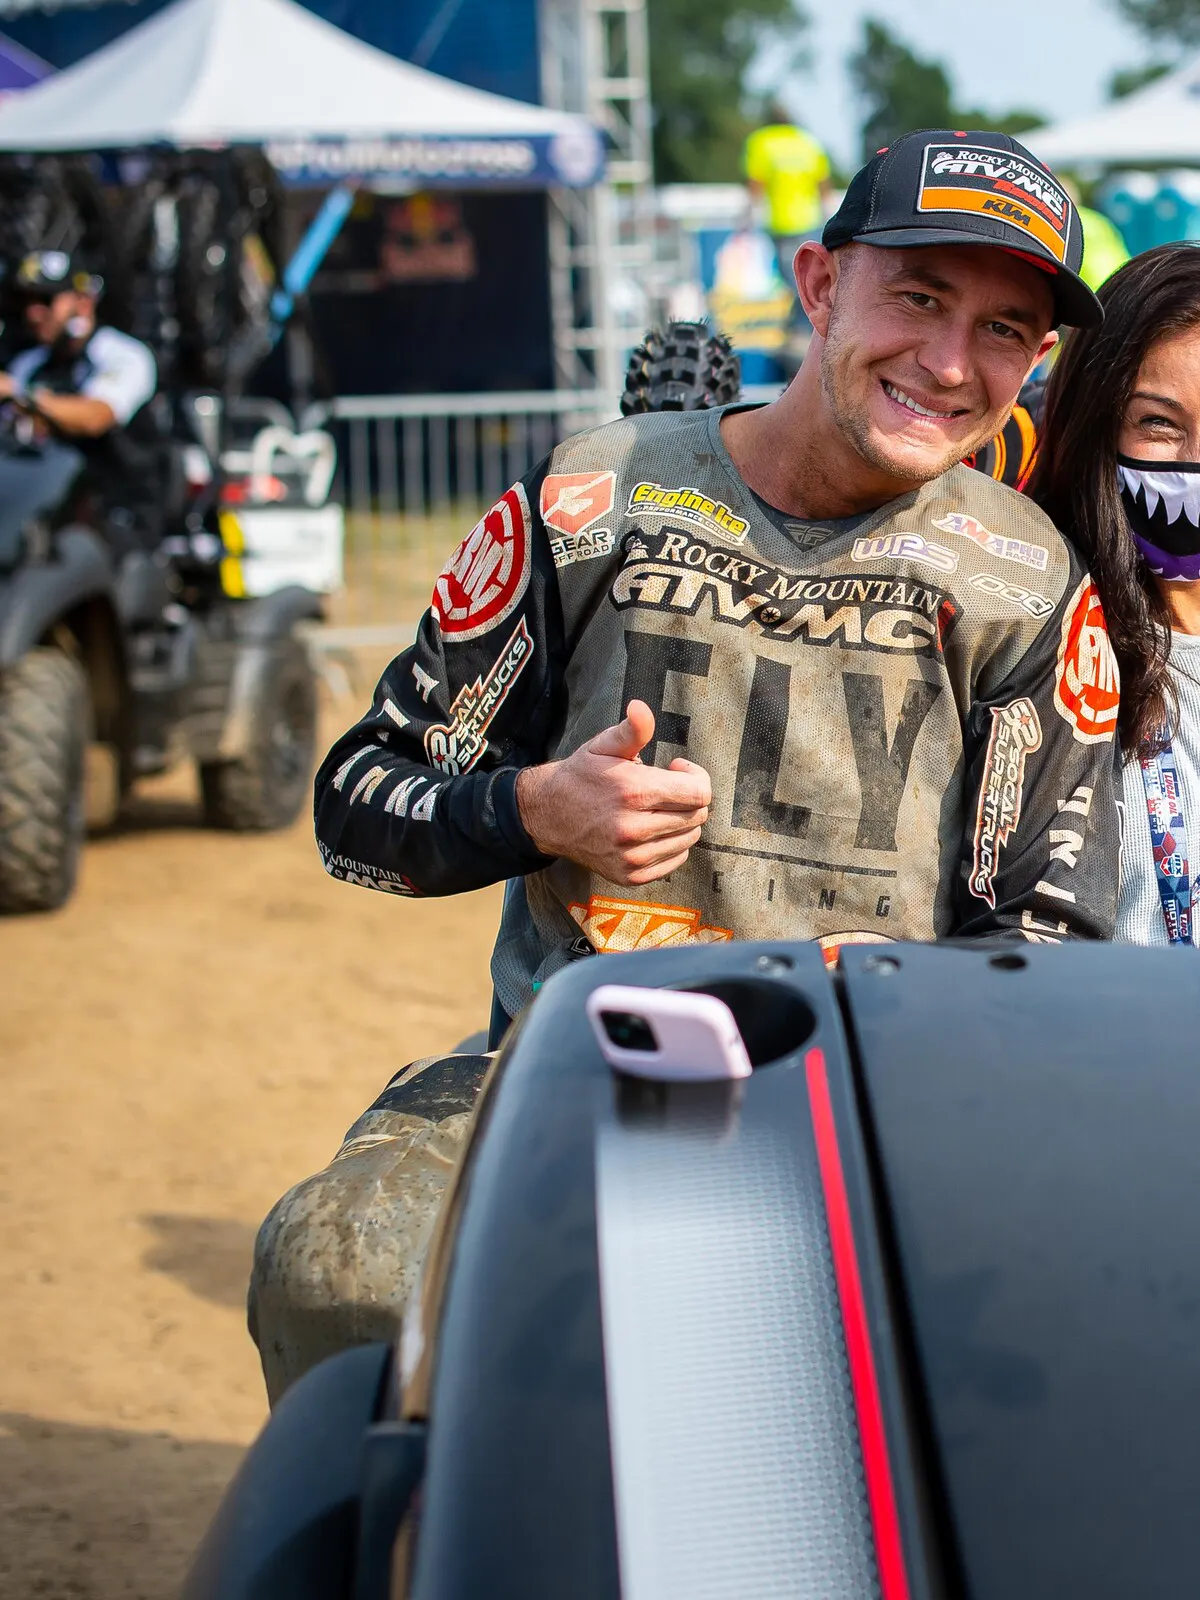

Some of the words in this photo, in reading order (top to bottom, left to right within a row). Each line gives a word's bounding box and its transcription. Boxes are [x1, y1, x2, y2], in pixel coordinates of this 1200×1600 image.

[956, 150, 1008, 166] ROCKY
[1008, 159, 1064, 205] MOUNTAIN
[982, 199, 1031, 226] KTM
[634, 484, 716, 517] Engine
[714, 505, 746, 537] Ice
[551, 530, 608, 556] GEAR
[942, 515, 1004, 555] AMA
[1006, 540, 1046, 561] PRO
[1005, 551, 1044, 568] RACING
[656, 532, 768, 587] ROCKY
[766, 577, 943, 614] MOUNTAIN
[618, 630, 946, 852] FLY
[974, 722, 1010, 893] SUPERTRUCKS
[1001, 745, 1020, 827] SOCAL
[1164, 774, 1175, 799] LUCAS
[1168, 801, 1177, 815] OIL
[329, 853, 402, 882] MOUNTAIN
